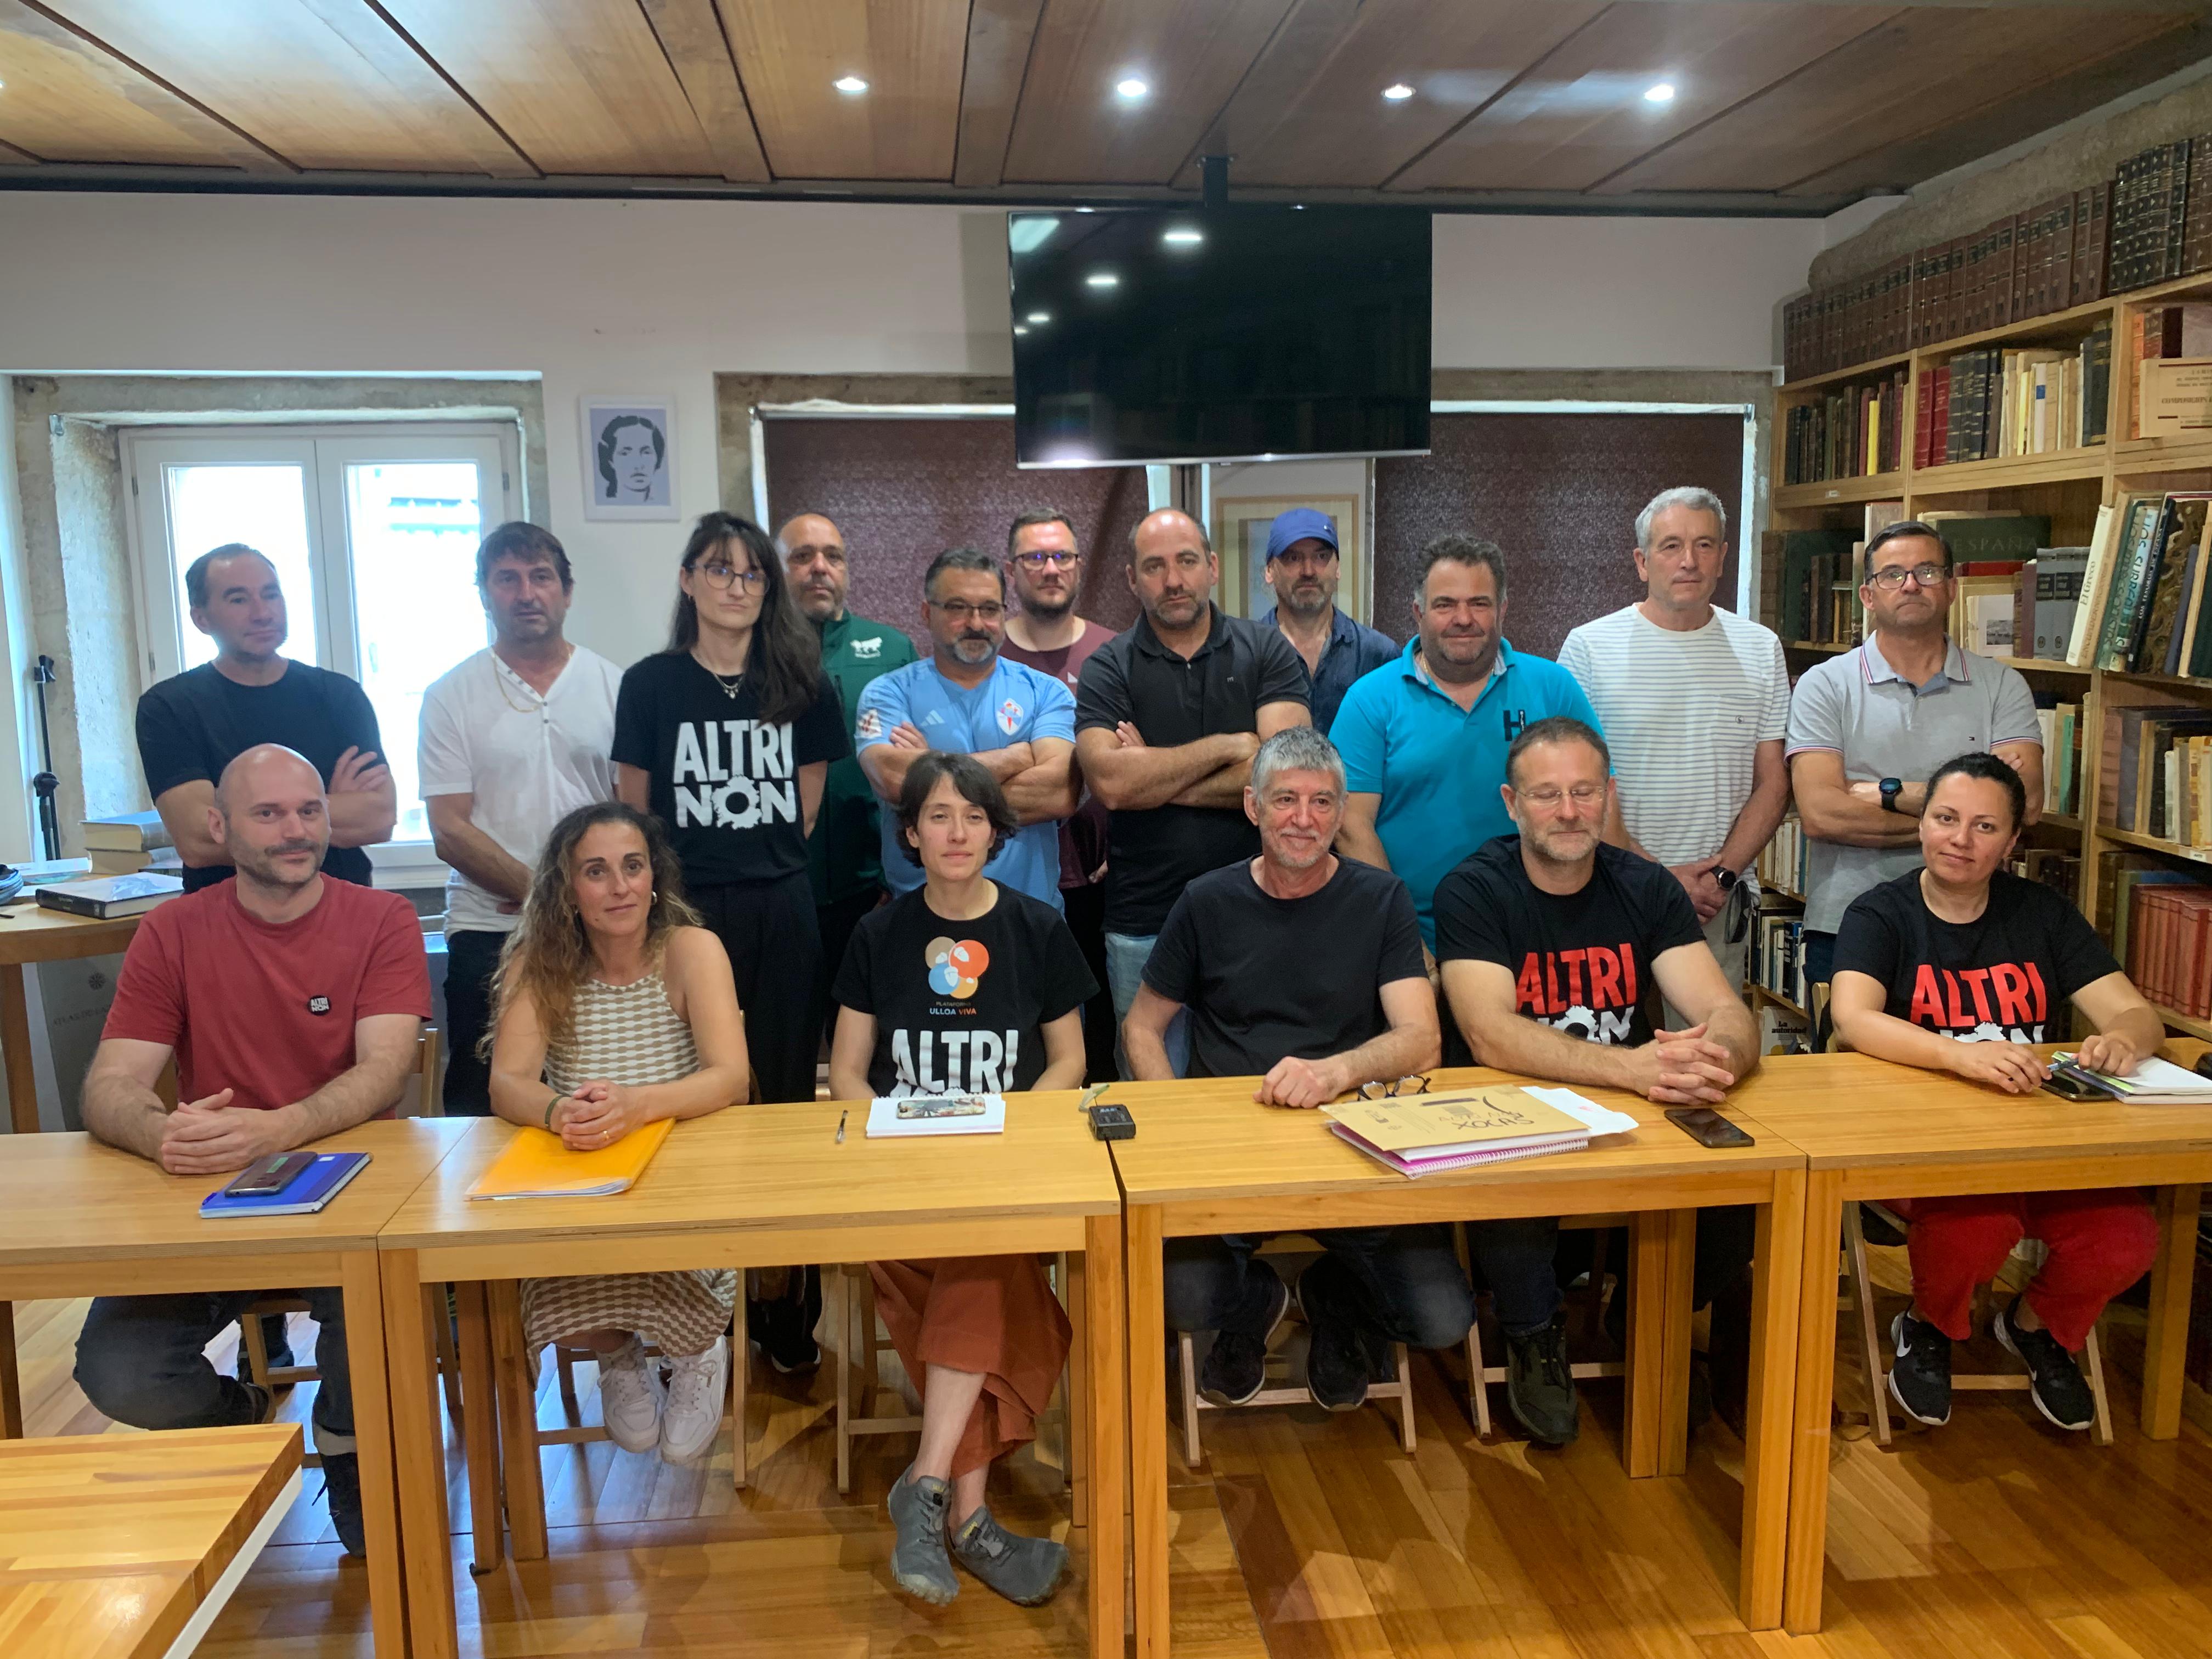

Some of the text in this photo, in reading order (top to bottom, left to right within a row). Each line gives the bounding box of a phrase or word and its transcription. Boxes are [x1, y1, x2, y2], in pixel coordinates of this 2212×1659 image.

[2083, 561, 2096, 592] Greco
[674, 719, 794, 784] ALTRI
[674, 775, 797, 830] NON
[1516, 943, 1637, 1014] ALTRI
[1910, 962, 2046, 1028] ALTRI
[1537, 1005, 1635, 1045] ON
[891, 1029, 1019, 1093] ALTRI
